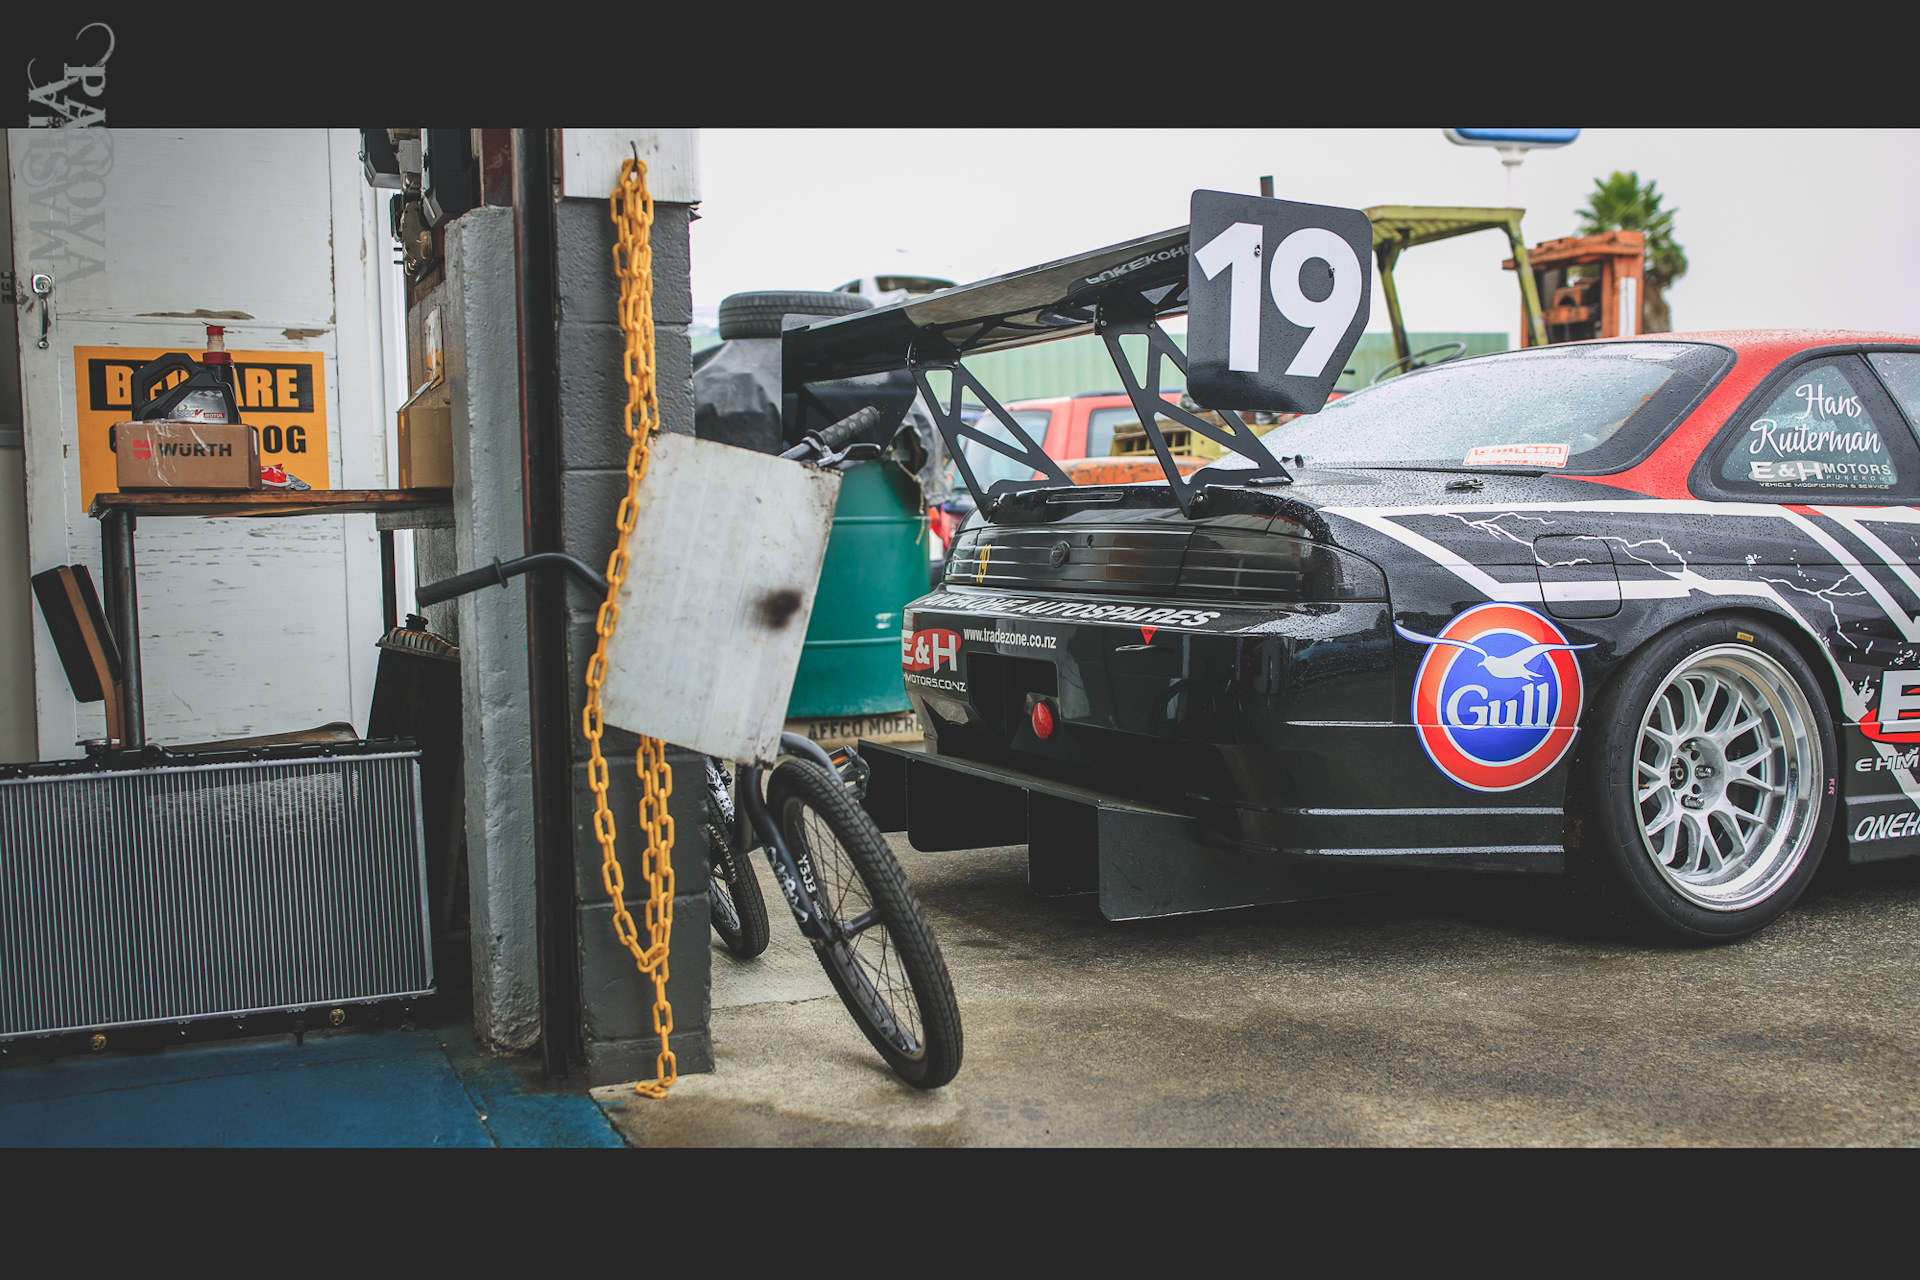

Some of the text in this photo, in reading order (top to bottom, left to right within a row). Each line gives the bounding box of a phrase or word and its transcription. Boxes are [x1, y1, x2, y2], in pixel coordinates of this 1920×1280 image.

[1193, 221, 1362, 378] 19
[1795, 383, 1862, 421] Hans
[158, 442, 232, 457] WÜRTH
[251, 424, 306, 454] OG
[1749, 418, 1881, 458] Ruiterman
[1749, 461, 1892, 482] E&H MOTORS
[1826, 474, 1893, 483] PUKEKOHE
[1008, 601, 1221, 627] AUTOSPARES
[901, 629, 957, 675] E&H
[963, 627, 1057, 649] www.tradezone.co.nz
[1446, 682, 1550, 730] Gull
[807, 720, 863, 740] AFFCO
[1853, 811, 1920, 842] ONEH
